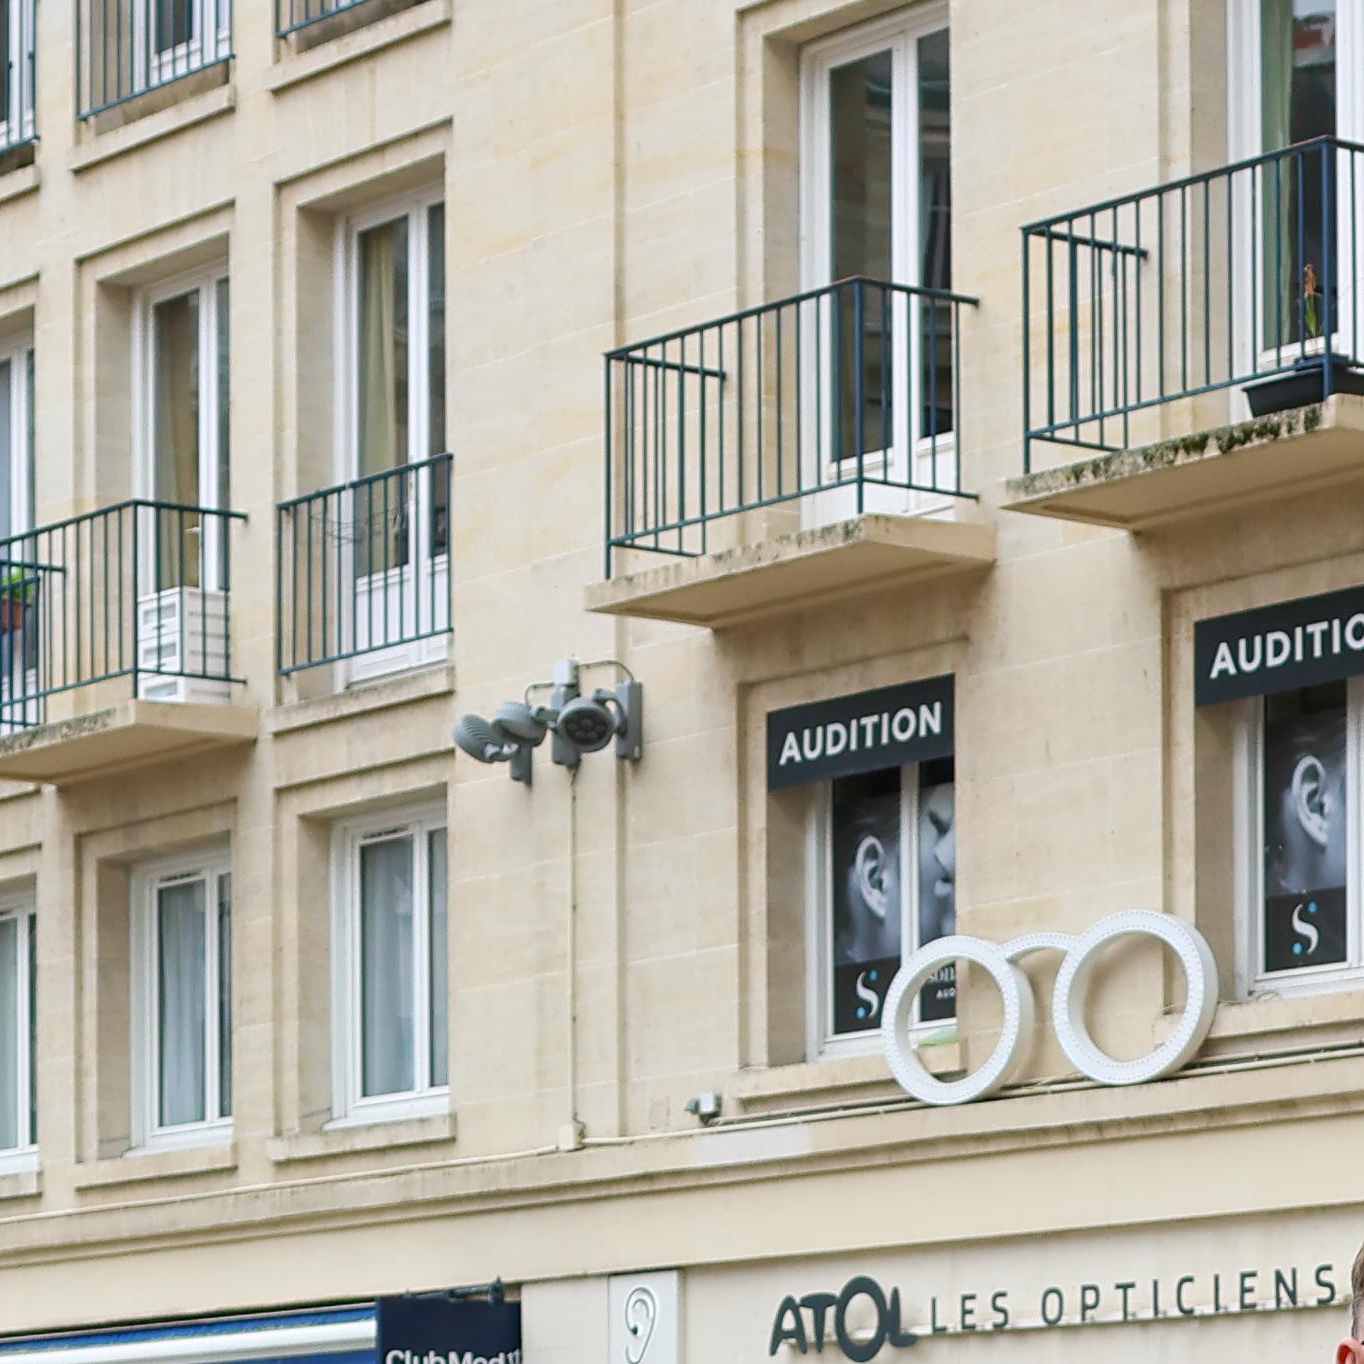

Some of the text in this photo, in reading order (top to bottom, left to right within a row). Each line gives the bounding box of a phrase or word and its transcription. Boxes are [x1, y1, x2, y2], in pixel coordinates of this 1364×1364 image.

[778, 701, 942, 766] AUDITION
[769, 1263, 1337, 1363] ATOL LES OPTICIENS
